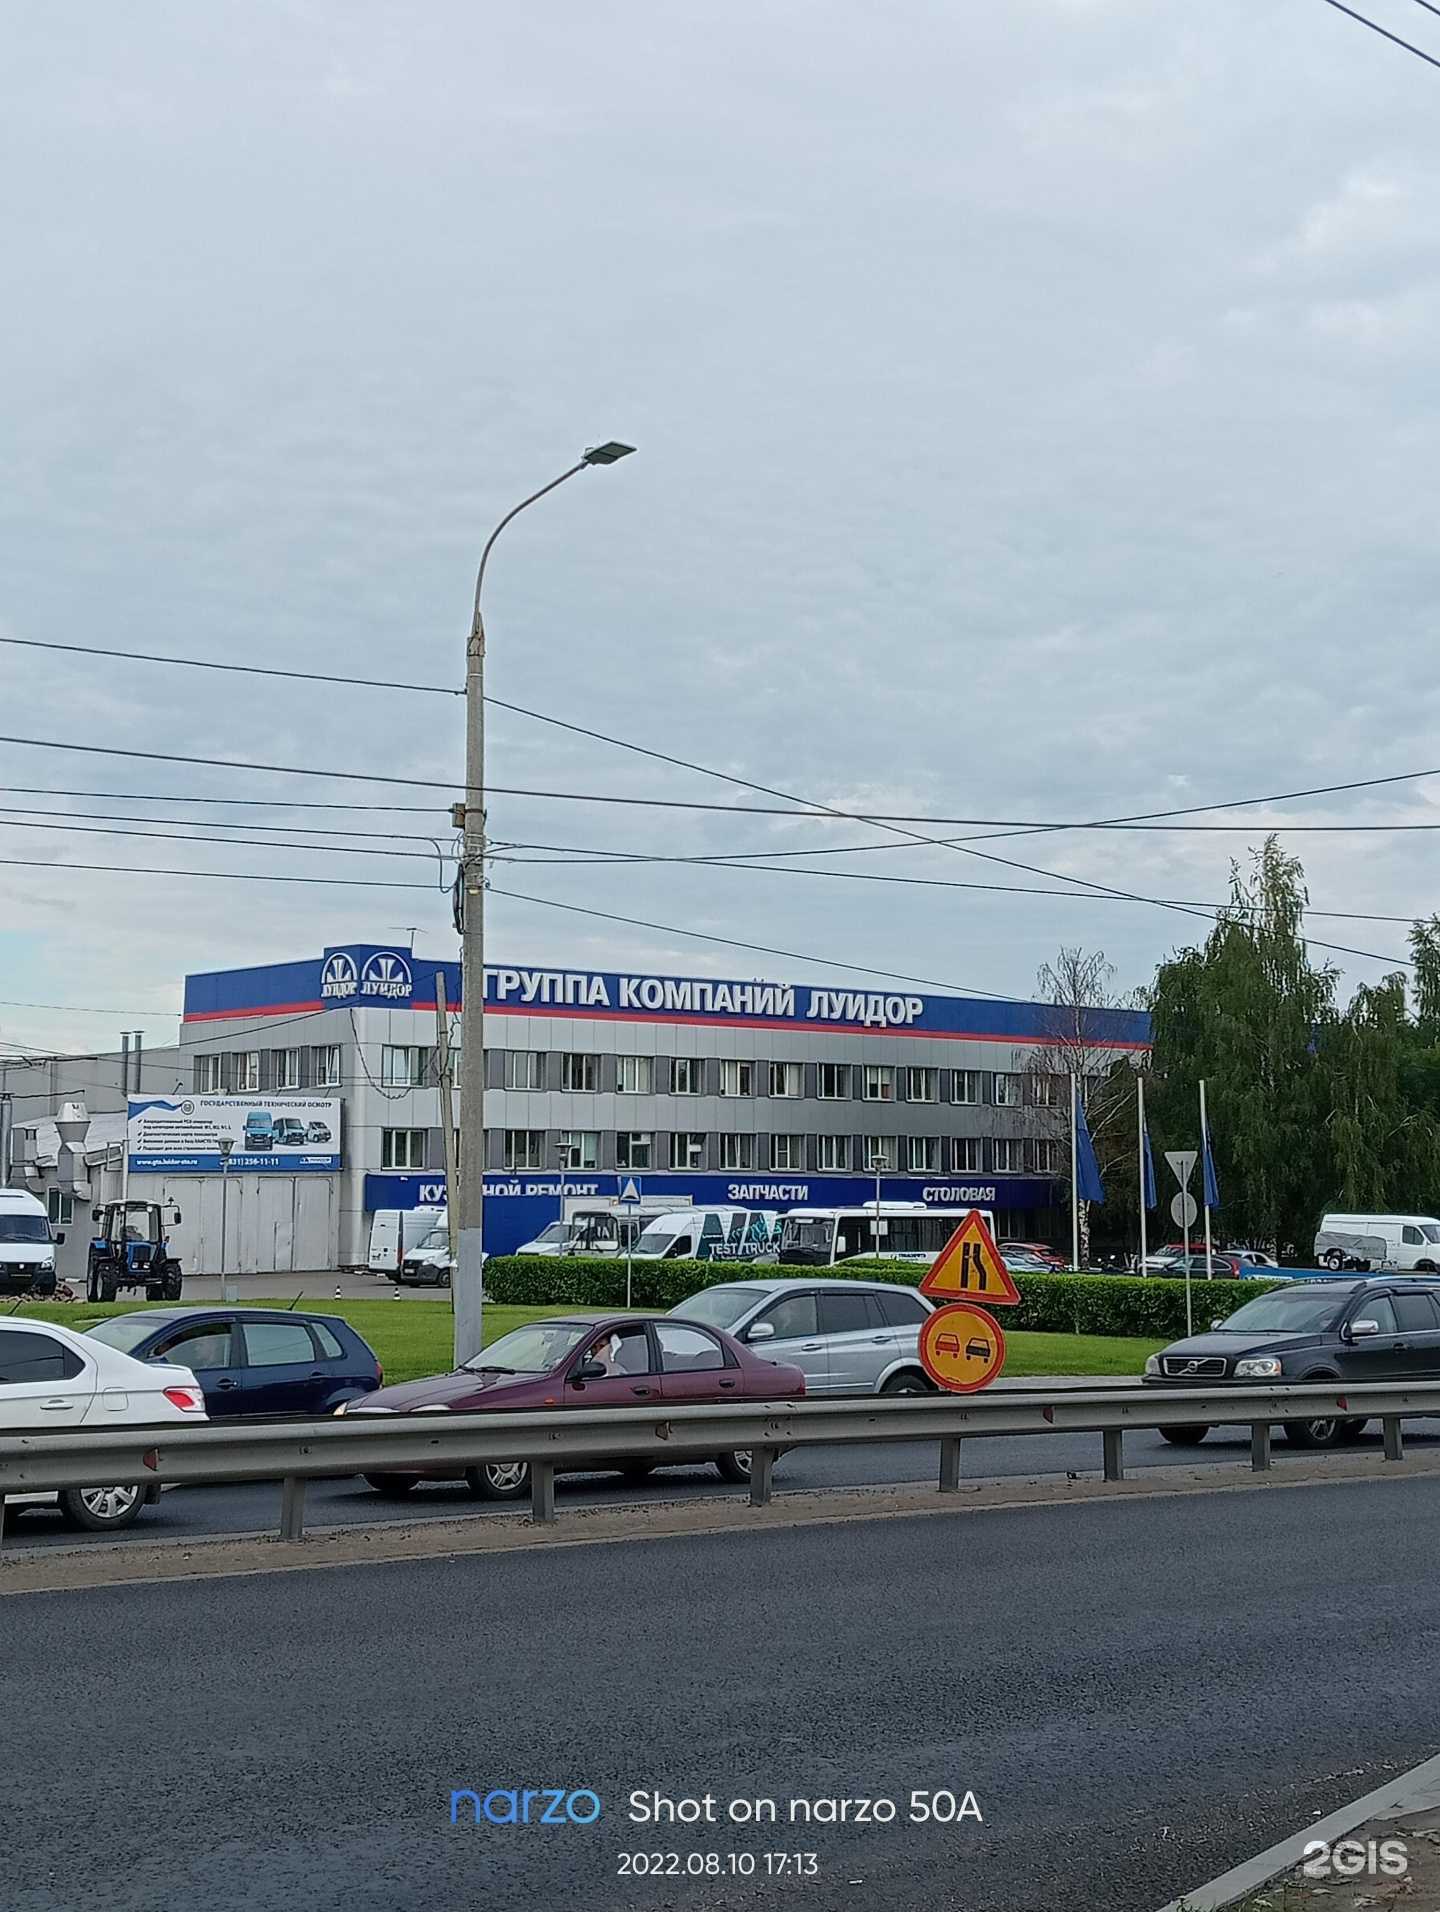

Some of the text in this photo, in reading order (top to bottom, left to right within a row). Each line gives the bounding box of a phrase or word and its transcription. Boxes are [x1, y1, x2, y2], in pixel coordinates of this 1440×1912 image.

[360, 982, 412, 999] ЛУИДОР
[482, 968, 923, 1027] ГРУППА КОМПАНИЙ ЛУИДОР
[727, 1184, 808, 1201] ЗАПЧАСТИ
[922, 1186, 996, 1202] СТОЛОВАЯ
[709, 1241, 781, 1255] TEST TRUCK
